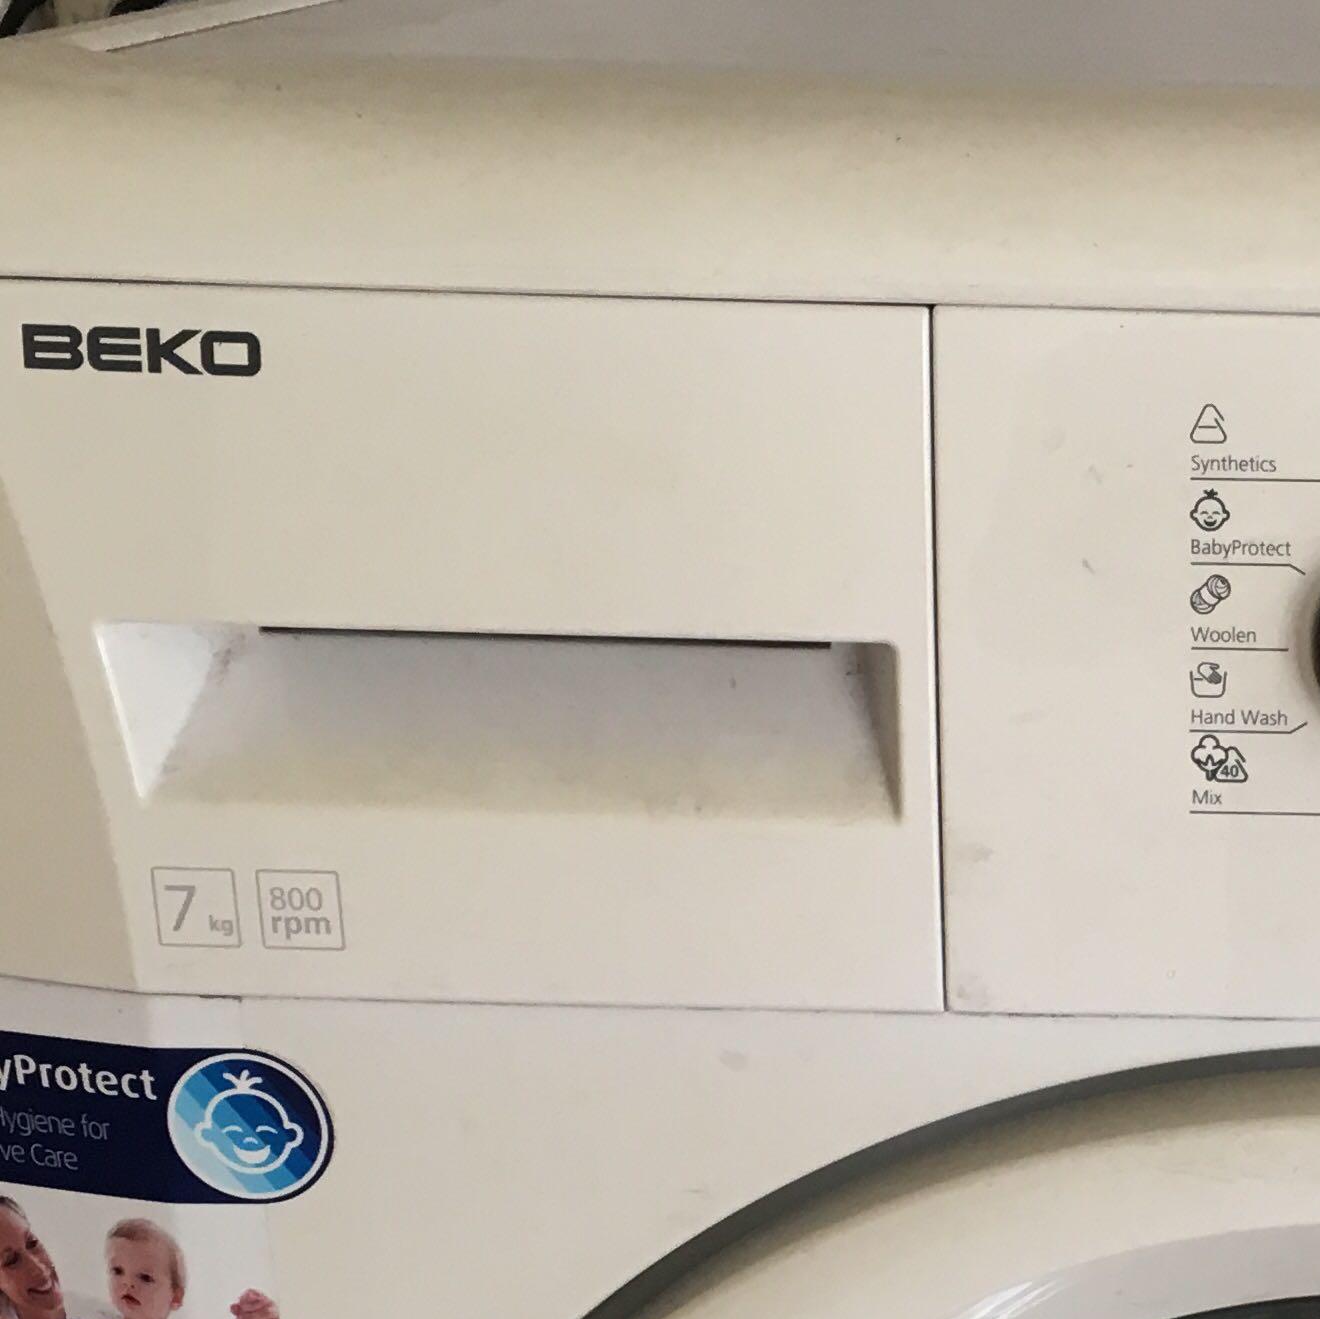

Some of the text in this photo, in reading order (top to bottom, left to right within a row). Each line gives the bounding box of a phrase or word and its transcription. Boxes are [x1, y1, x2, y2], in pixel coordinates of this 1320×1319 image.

[21, 323, 262, 377] BEKO
[1190, 454, 1278, 474] Synthetics
[1190, 538, 1292, 559] BabyProtect
[1190, 625, 1257, 643] Woolen
[1190, 709, 1289, 727] Hand Wash
[1220, 763, 1241, 778] 40
[1191, 789, 1223, 806] Mix
[163, 884, 197, 933] 7
[268, 886, 324, 912] 800
[207, 914, 235, 937] kg
[271, 914, 333, 941] rpm
[0, 1054, 158, 1101] yProtect
[81, 1112, 111, 1141] for
[30, 1142, 79, 1172] Care
